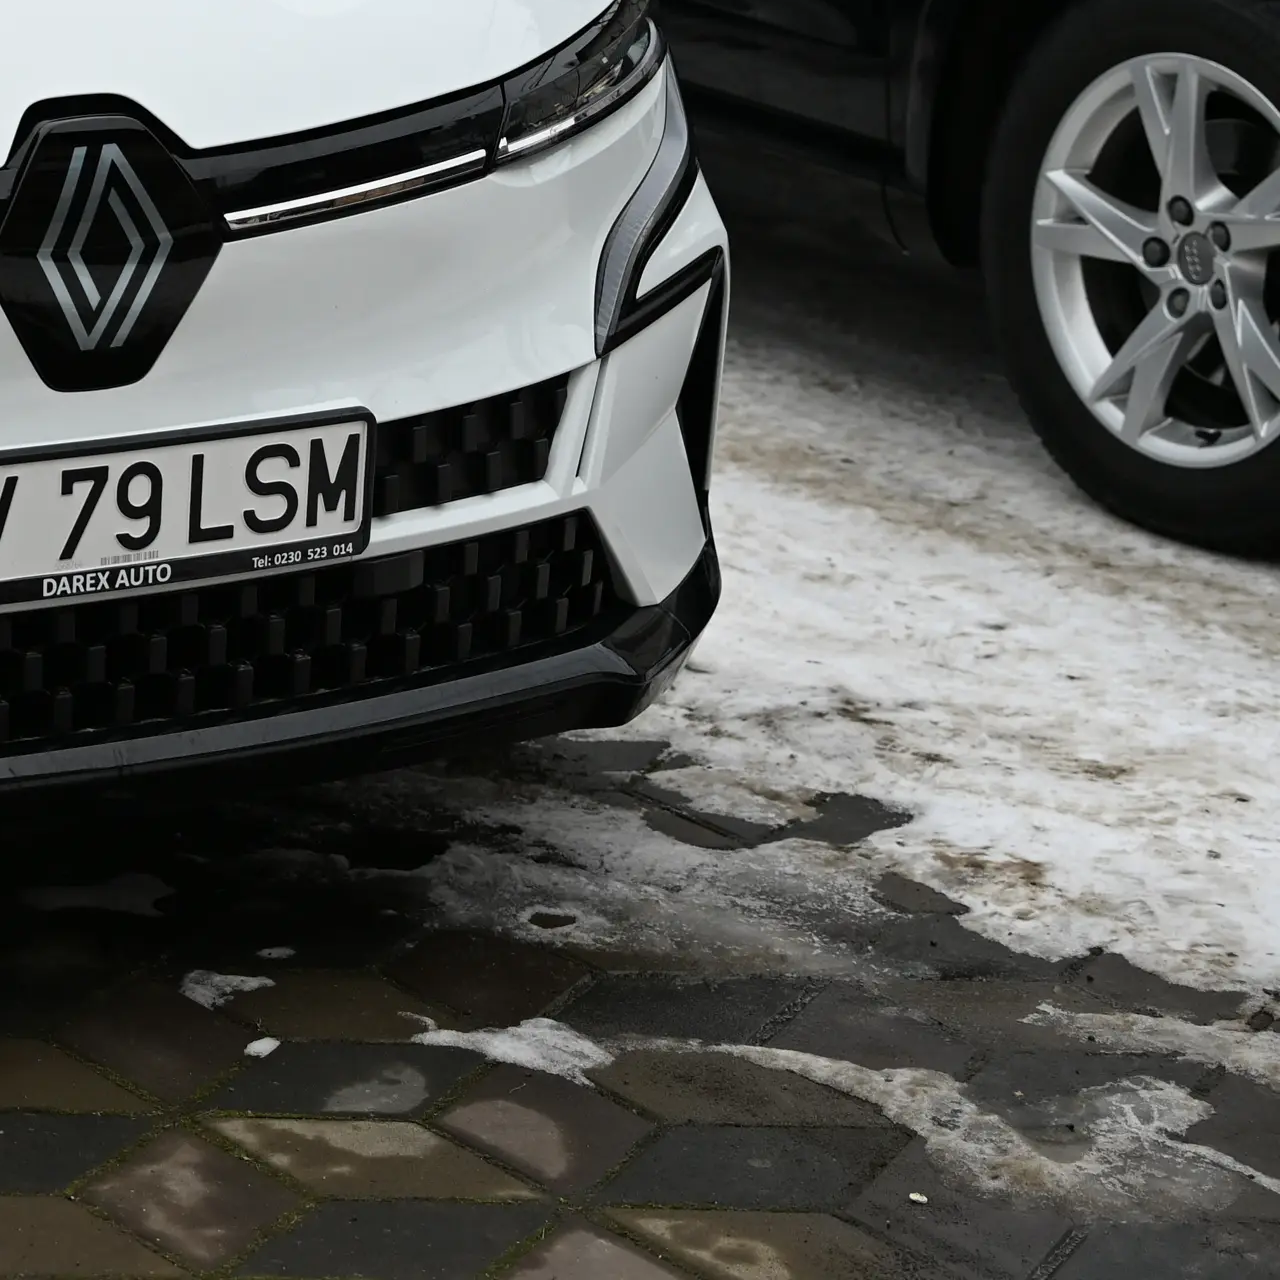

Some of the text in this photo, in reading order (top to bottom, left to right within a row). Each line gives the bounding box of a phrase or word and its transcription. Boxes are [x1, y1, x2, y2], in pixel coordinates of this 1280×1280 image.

[59, 460, 164, 560] 79
[188, 433, 361, 544] LSM
[252, 542, 353, 569] Tel: 0230 523 014
[42, 571, 110, 597] DAREX
[114, 563, 172, 589] AUTO
